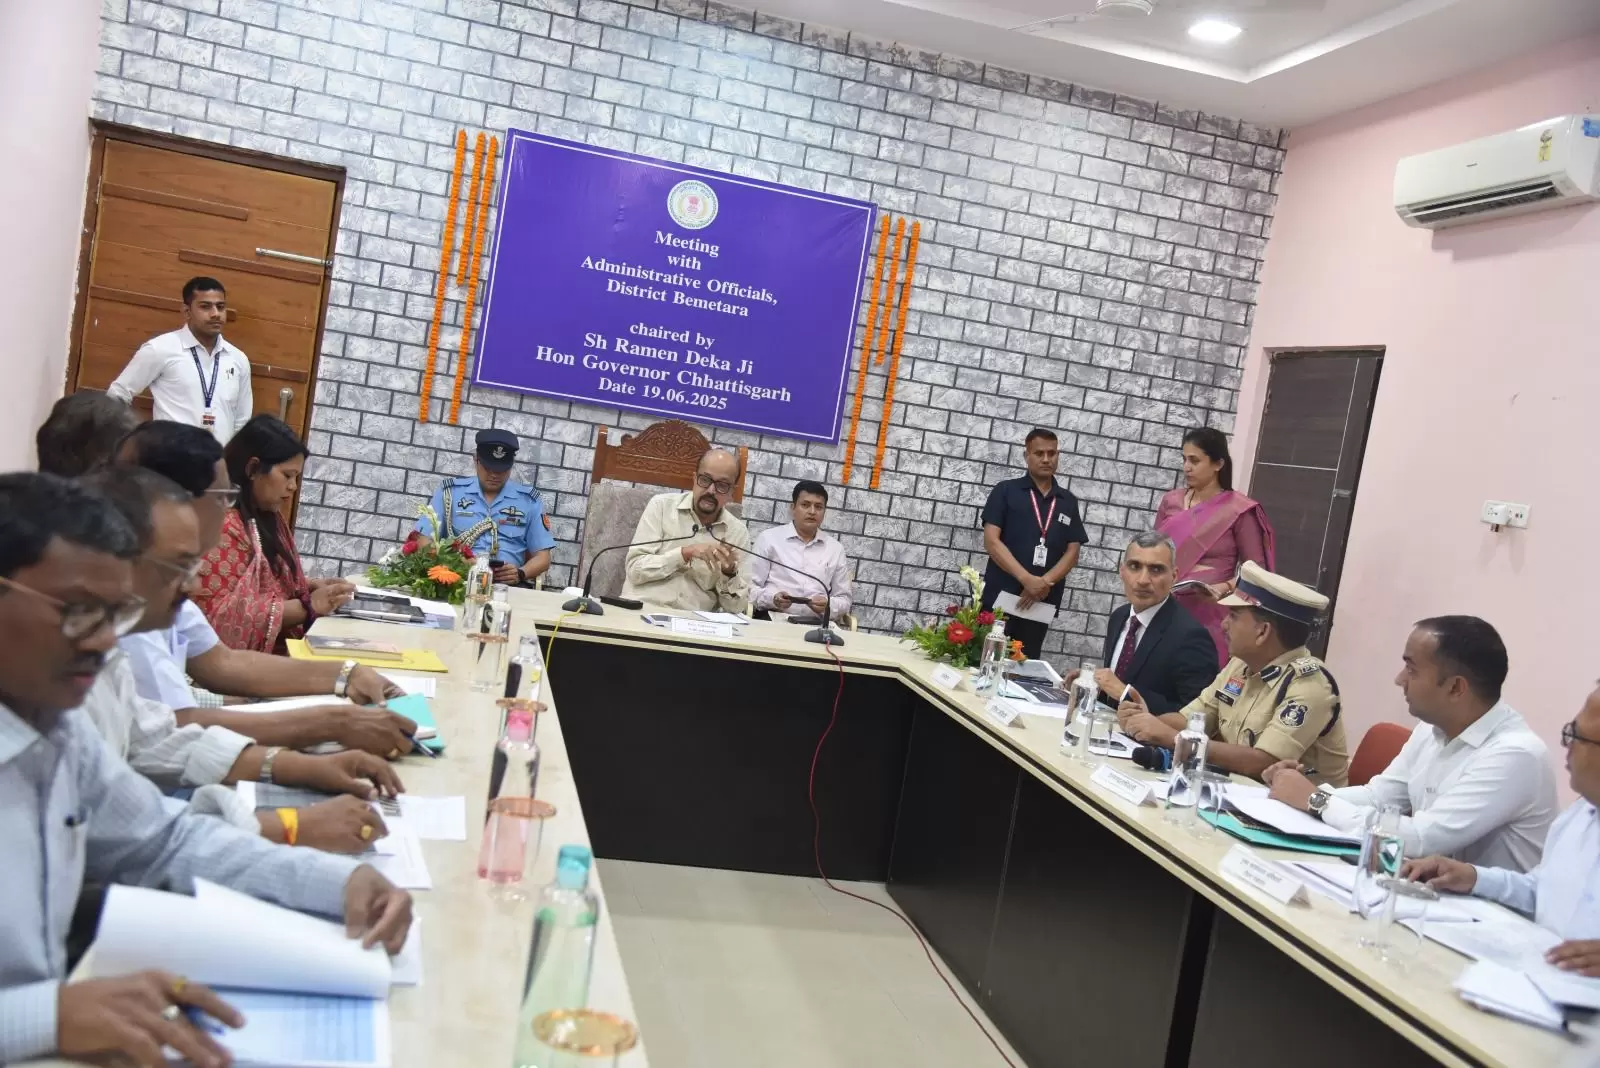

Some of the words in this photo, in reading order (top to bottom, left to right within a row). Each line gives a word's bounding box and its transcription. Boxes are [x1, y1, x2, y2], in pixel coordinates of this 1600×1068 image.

[654, 230, 720, 258] Meeting
[580, 255, 701, 289] Administrative
[707, 279, 778, 306] Officials,
[667, 254, 702, 271] with
[606, 278, 667, 302] District
[672, 290, 749, 317] Bemetara
[583, 332, 607, 350] Sh
[614, 337, 678, 362] Ramen
[685, 349, 731, 371] Deka
[736, 359, 754, 375] Ji
[629, 322, 690, 344] chaired
[695, 332, 716, 350] by
[535, 345, 575, 366] Hon
[582, 354, 671, 381] Governor
[677, 370, 791, 402] Chhattisgarh
[598, 376, 636, 395] Date
[641, 384, 728, 410] 19.06.2025
